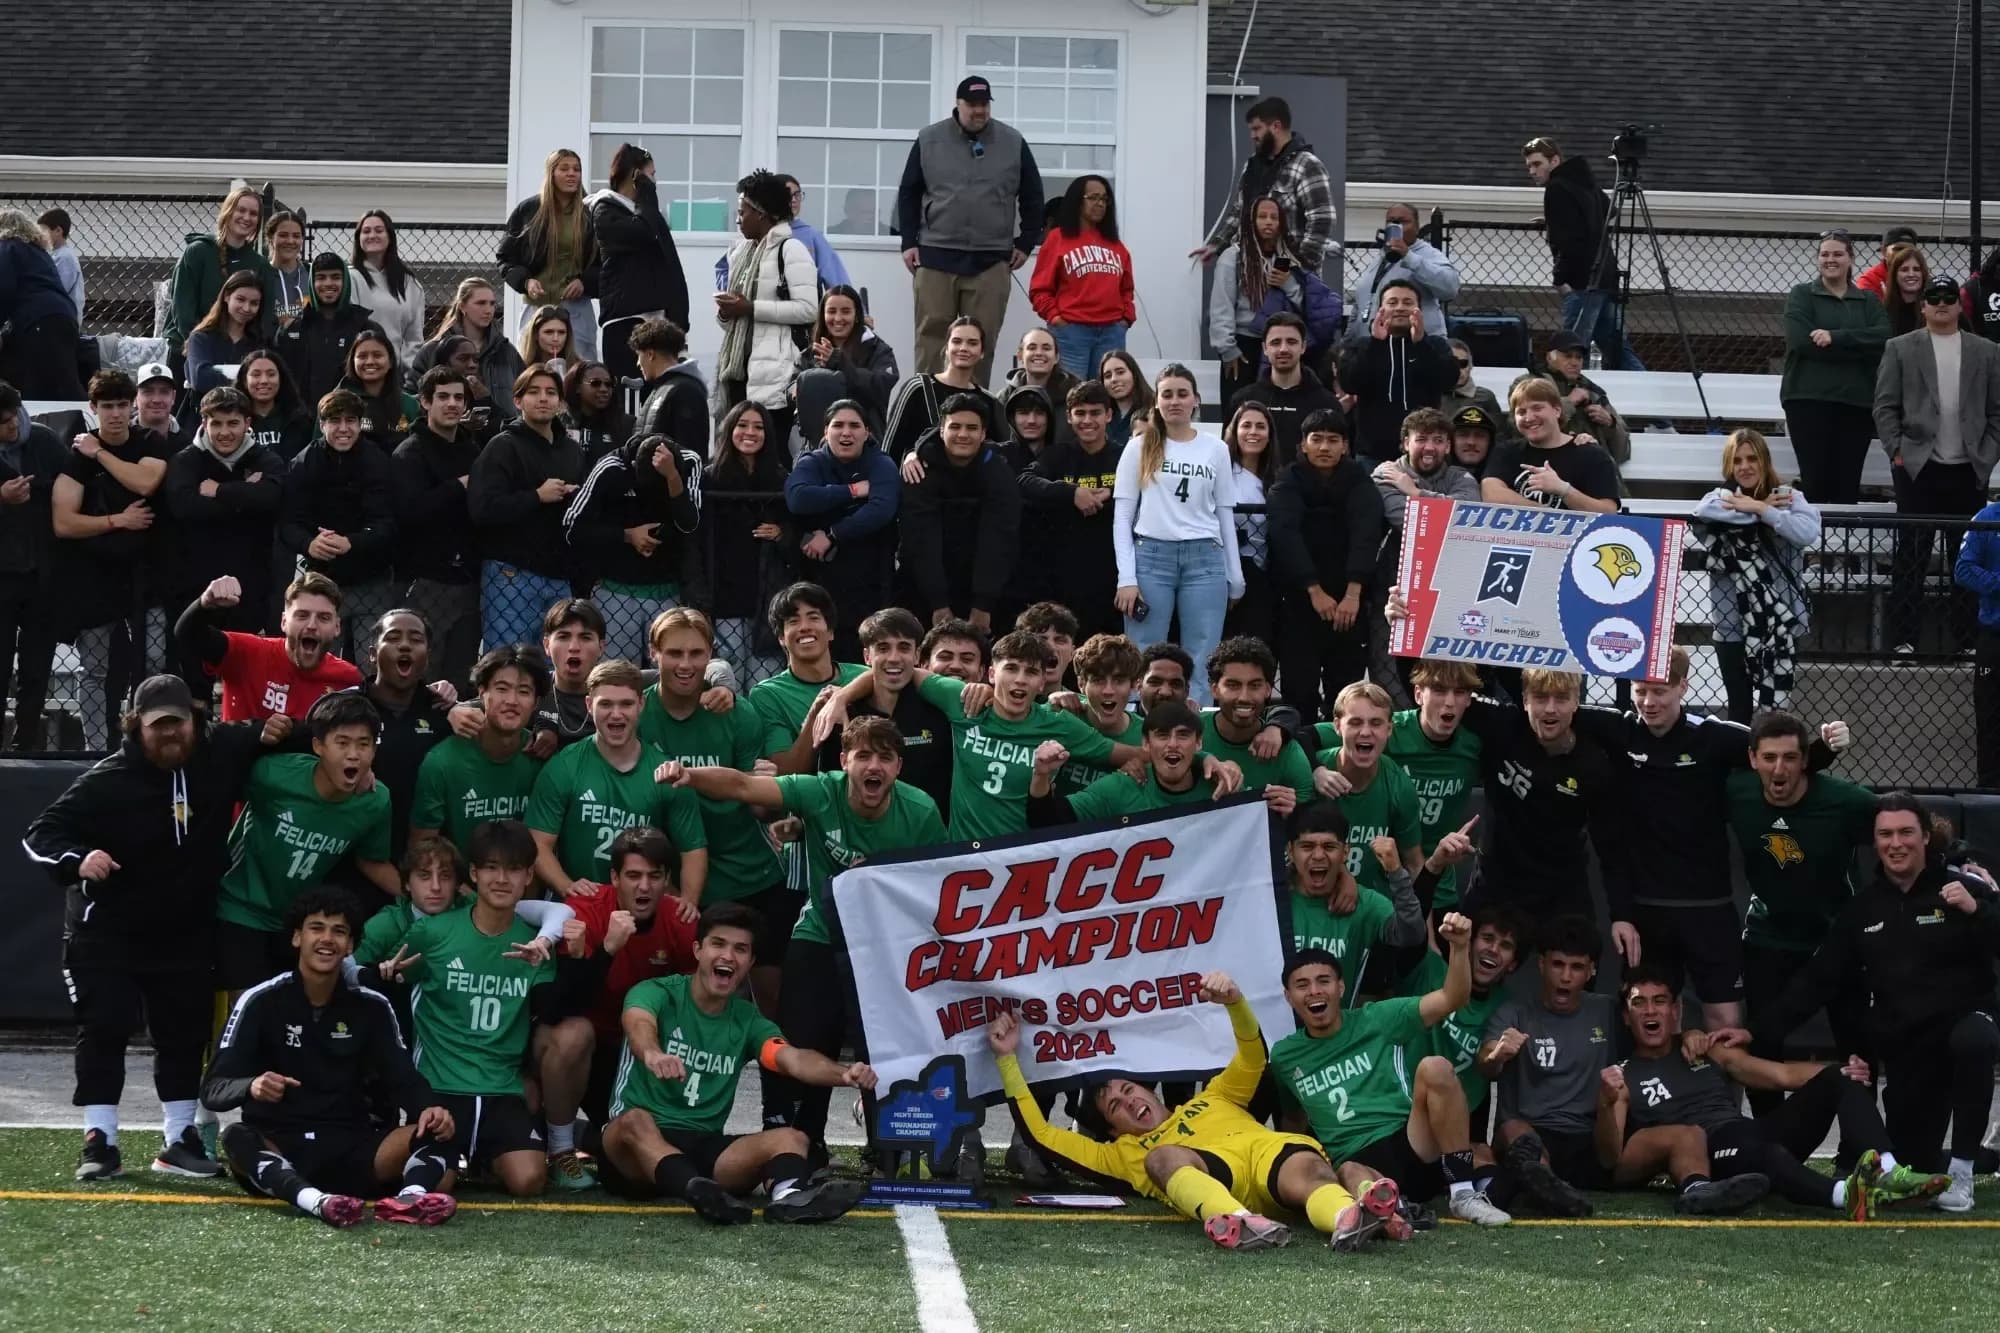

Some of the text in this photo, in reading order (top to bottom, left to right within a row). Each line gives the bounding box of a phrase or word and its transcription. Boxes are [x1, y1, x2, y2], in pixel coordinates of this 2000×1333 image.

[1063, 245, 1122, 275] CALDWELL
[1076, 263, 1123, 278] UNIVERSITY
[1160, 461, 1213, 480] ELICIAN
[1174, 477, 1190, 503] 4
[1453, 504, 1586, 536] TICKET
[1427, 636, 1568, 667] PUNCHED
[262, 688, 288, 713] 99
[983, 761, 1007, 794] 3
[1411, 778, 1464, 797] LICIAN
[581, 803, 651, 829] FELICIAN
[275, 821, 350, 854] FELICIAN
[594, 826, 623, 860] 2
[287, 850, 319, 880] 14
[933, 837, 1174, 936] CACC
[905, 896, 1224, 992] CHAMPION
[447, 971, 528, 998] FELICIAN
[469, 997, 501, 1031] 10
[936, 972, 1208, 1040] MEN'S SOCCER
[1034, 1030, 1115, 1064] 2024
[1536, 1046, 1557, 1067] 47
[683, 1072, 700, 1107] 4
[1296, 1052, 1372, 1099] FELICIAN
[1328, 1087, 1356, 1122] 2
[1642, 1083, 1673, 1107] 24
